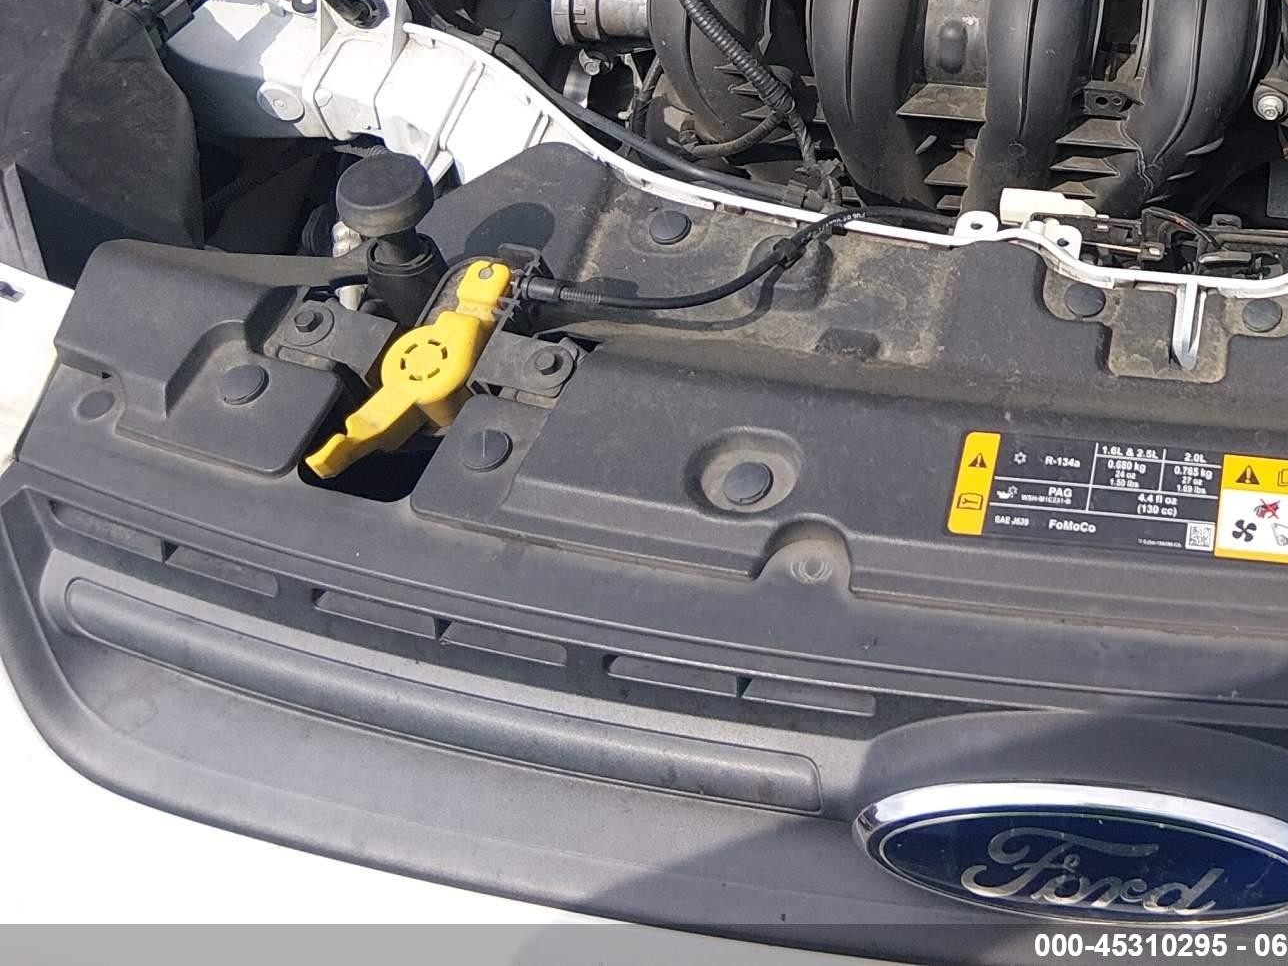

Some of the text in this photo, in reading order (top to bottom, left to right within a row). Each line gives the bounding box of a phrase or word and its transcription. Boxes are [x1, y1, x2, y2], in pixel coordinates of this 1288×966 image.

[1102, 445, 1123, 456] 1.6L
[1126, 447, 1134, 457] &
[1045, 455, 1081, 468] R-134a
[1184, 452, 1207, 463] 2.0L
[1134, 462, 1146, 474] kg
[1201, 468, 1213, 480] kg
[1115, 470, 1136, 480] 24 oz
[1181, 476, 1203, 486] 27 oz
[1048, 486, 1073, 498] PAG
[1138, 493, 1178, 505] 4.4 fl oz
[1137, 504, 1178, 517] (130 cc)
[1048, 519, 1097, 533] FoMoCo
[960, 825, 1225, 916] Ford
